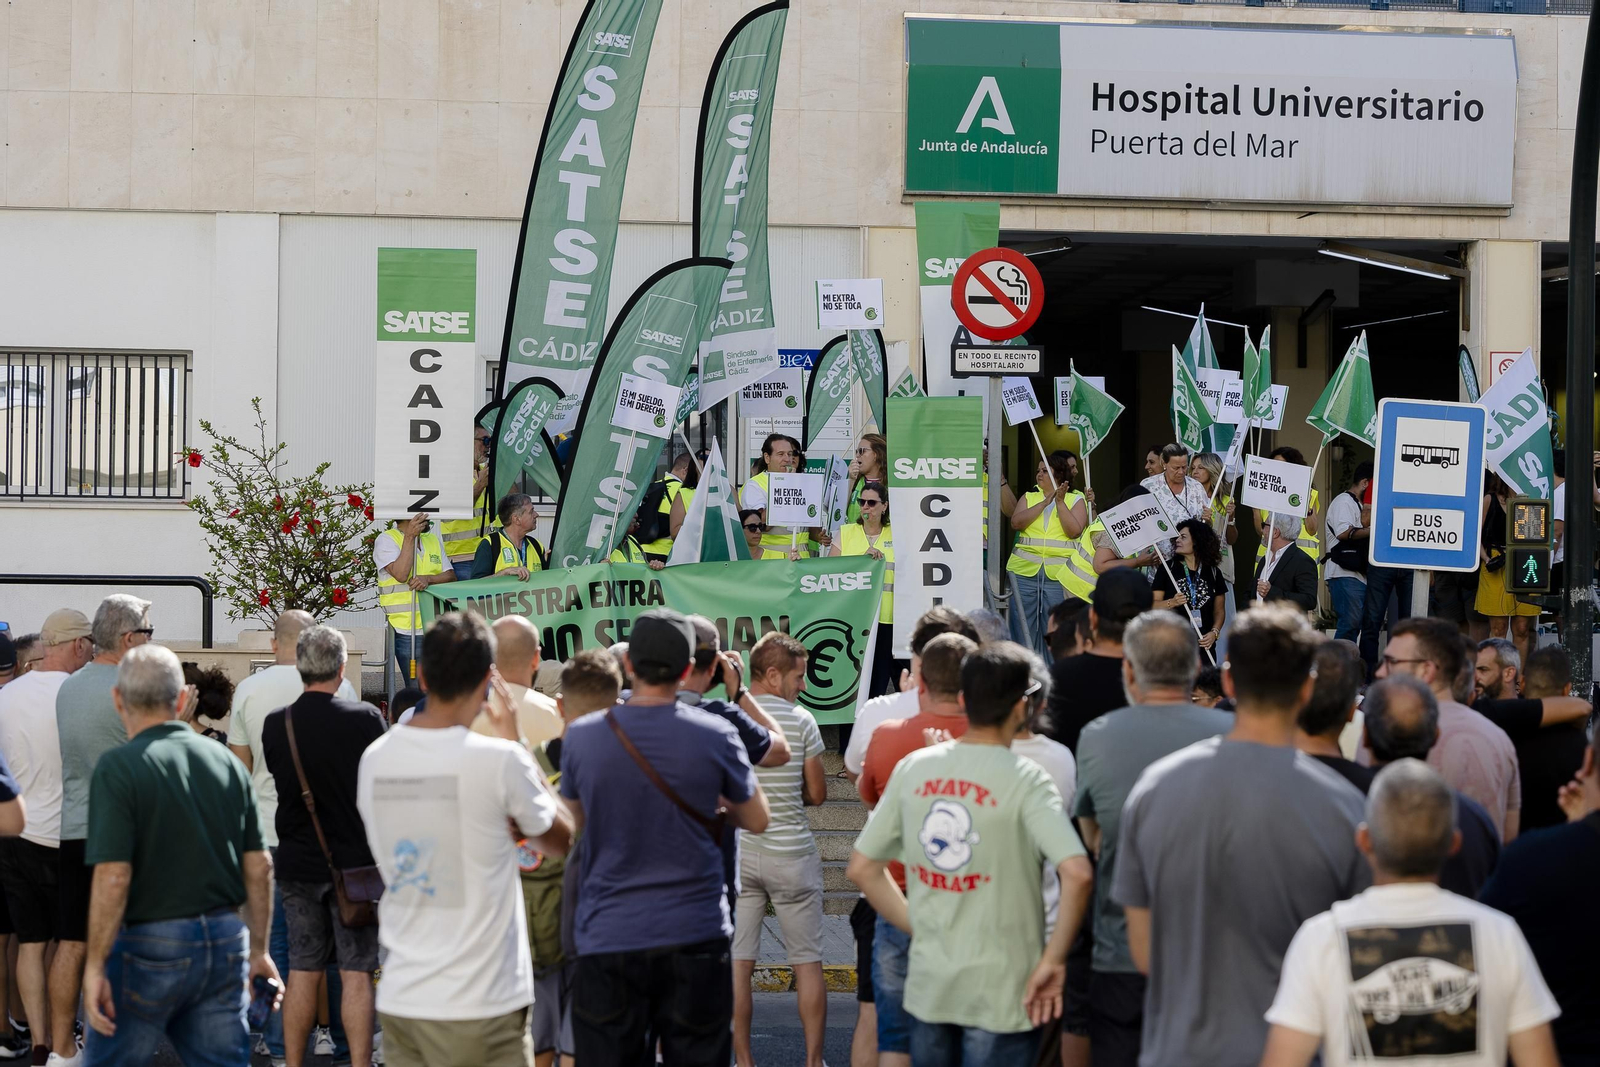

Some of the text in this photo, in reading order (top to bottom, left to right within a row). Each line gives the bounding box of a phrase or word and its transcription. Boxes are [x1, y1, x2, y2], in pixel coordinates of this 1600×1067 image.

[594, 31, 632, 49] SATSE
[1091, 82, 1485, 122] Hospital Universitario
[918, 139, 1048, 155] Junta de Andalucía
[1090, 129, 1298, 159] Puerta del Mar
[543, 65, 618, 329] SATSE
[822, 293, 856, 302] MI EXTRA
[823, 302, 862, 310] NO SE TOCA
[383, 311, 470, 334] SATSE
[640, 329, 683, 348] SATSE
[726, 349, 758, 359] Sindicato
[727, 360, 737, 368] de
[728, 367, 749, 375] Cádiz
[970, 361, 1025, 369] HOSPITALARIO
[621, 388, 629, 398] ES
[629, 391, 636, 400] MI
[743, 390, 783, 399] NI UN EURO
[753, 383, 762, 391] MI
[620, 397, 627, 406] ES
[627, 399, 634, 408] MI
[1225, 391, 1241, 400] POR
[503, 389, 540, 447] SATSE
[407, 348, 444, 513] CADIZ
[514, 400, 552, 455] Cádiz
[893, 457, 977, 480] SATSE
[1249, 470, 1282, 484] MI EXTRA
[773, 488, 803, 497] MI EXTRA
[1248, 479, 1287, 494] NO SE TOCA
[773, 497, 806, 505] NO SE TOCA
[1111, 519, 1128, 533] POR
[1126, 507, 1160, 524] NUESTRAS
[1413, 514, 1443, 528] BUS
[1115, 522, 1141, 540] PAGAS
[1396, 529, 1458, 545] URBANO
[799, 571, 873, 595] SATSE
[466, 584, 584, 620] NUESTRA
[588, 579, 665, 609] EXTRA
